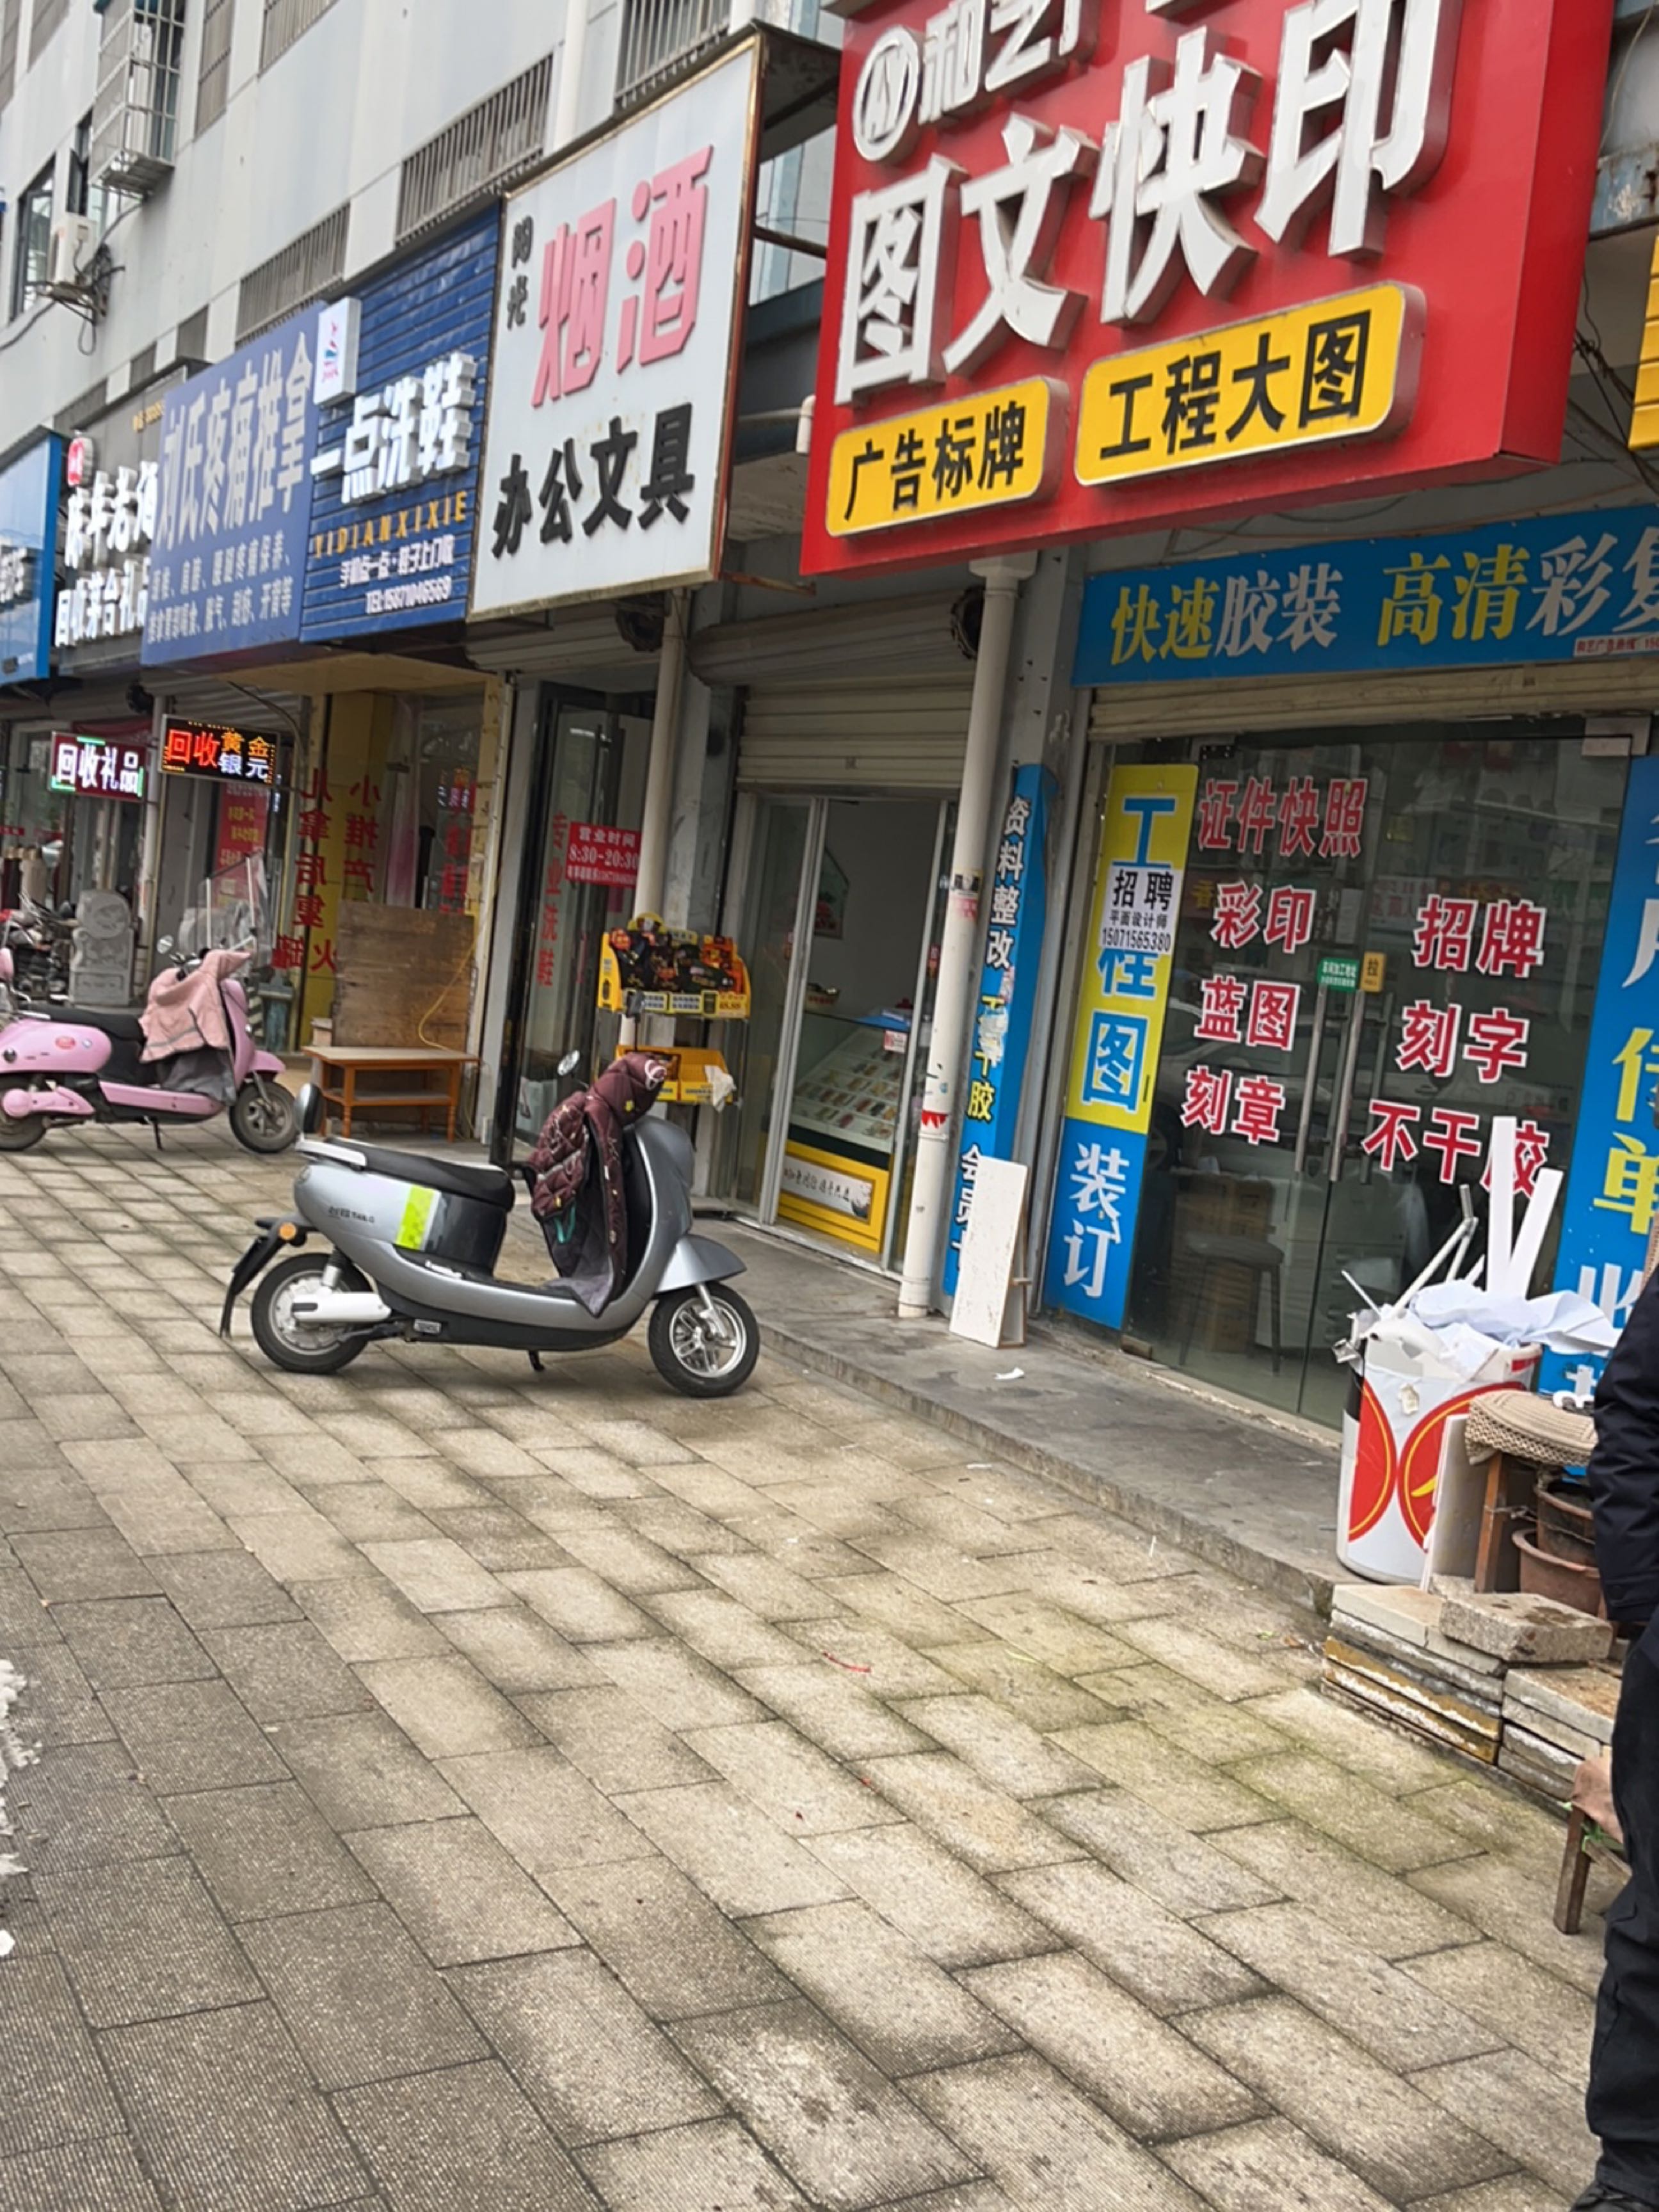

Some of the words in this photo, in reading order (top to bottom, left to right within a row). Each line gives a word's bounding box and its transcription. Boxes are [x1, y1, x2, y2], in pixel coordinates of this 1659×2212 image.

[834, 0, 1440, 407] 图文快印
[531, 145, 714, 408] 烟酒
[1099, 310, 1374, 461] 工程大图
[310, 351, 475, 504] 一点洗鞋
[843, 399, 1026, 522] 广告标牌
[492, 402, 694, 560] 办公文具
[314, 490, 468, 559] YIDIANXIXIE
[1110, 562, 1344, 666] 快速胶装
[56, 742, 140, 794] 回收礼品
[168, 728, 221, 768] 回收
[221, 730, 269, 758] 黄金
[218, 752, 269, 780] 银元
[579, 824, 636, 848] 营业时间
[1197, 777, 1367, 858] 证件快照
[986, 796, 1031, 970] 资料整改
[1109, 909, 1168, 930] 平面设计师
[1112, 869, 1174, 911] 招聘
[1211, 884, 1315, 954] 彩印
[1102, 927, 1171, 953] 15071565380
[1410, 894, 1546, 977] 招牌
[1194, 975, 1299, 1051] 蓝图
[1395, 999, 1530, 1083] 刻字
[1181, 1066, 1286, 1146] 刻章
[1361, 1098, 1550, 1201] 不干胶
[1062, 1142, 1130, 1298] 装订
